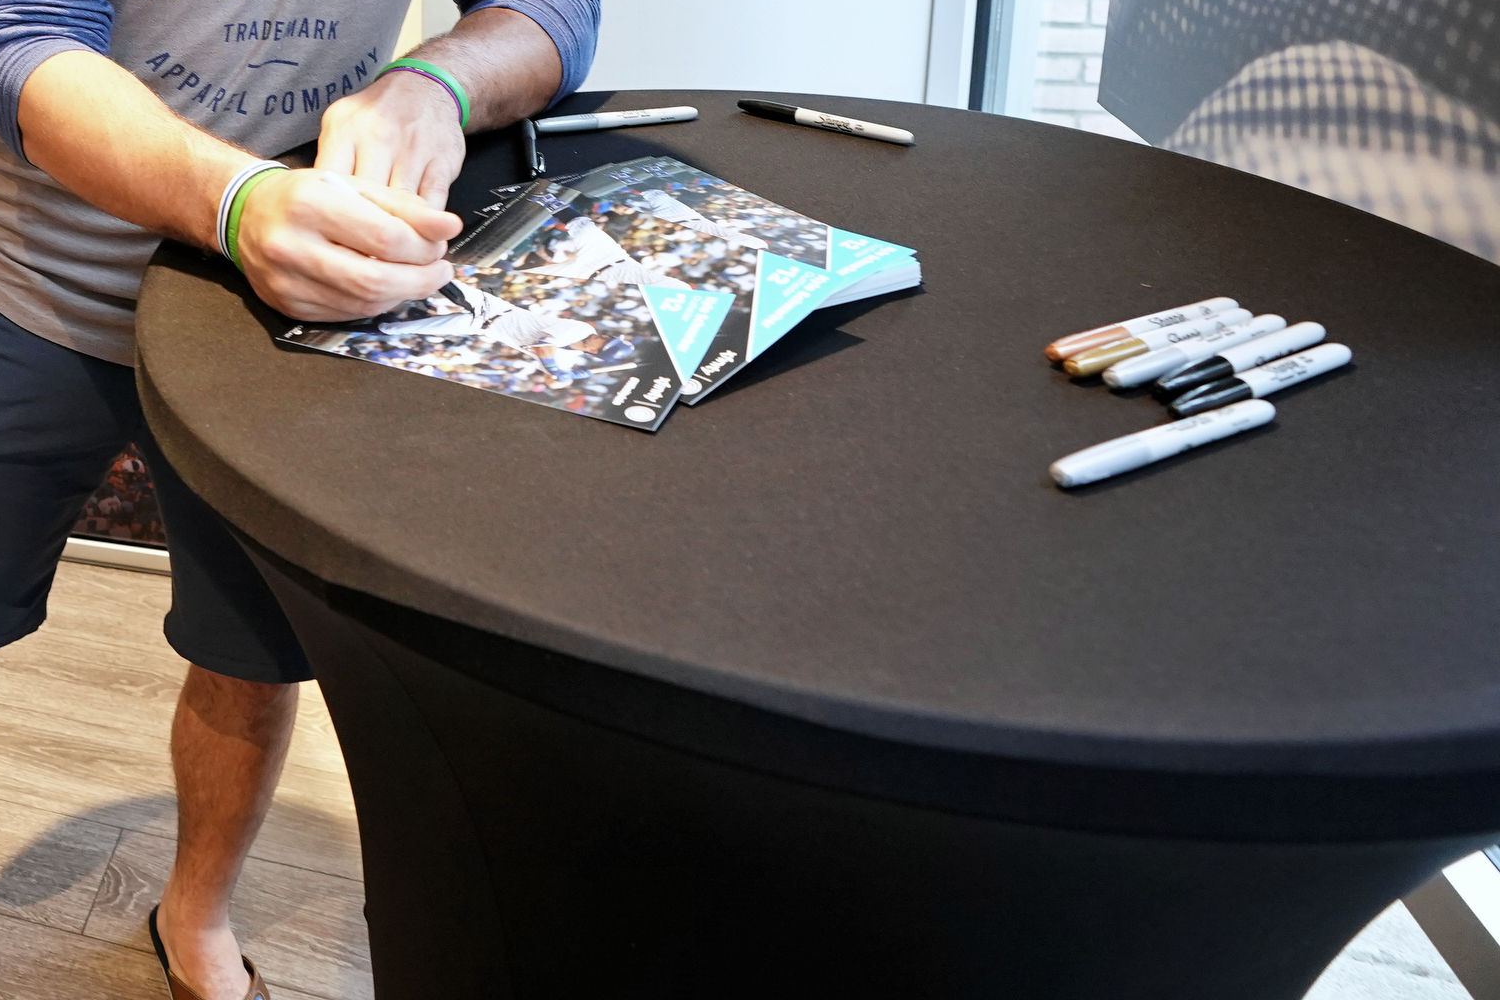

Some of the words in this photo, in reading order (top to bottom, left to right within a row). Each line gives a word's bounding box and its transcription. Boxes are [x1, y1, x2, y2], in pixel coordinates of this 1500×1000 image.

[224, 16, 341, 43] TRADEMARK
[145, 51, 248, 116] APPAREL
[263, 47, 380, 117] COMPANY
